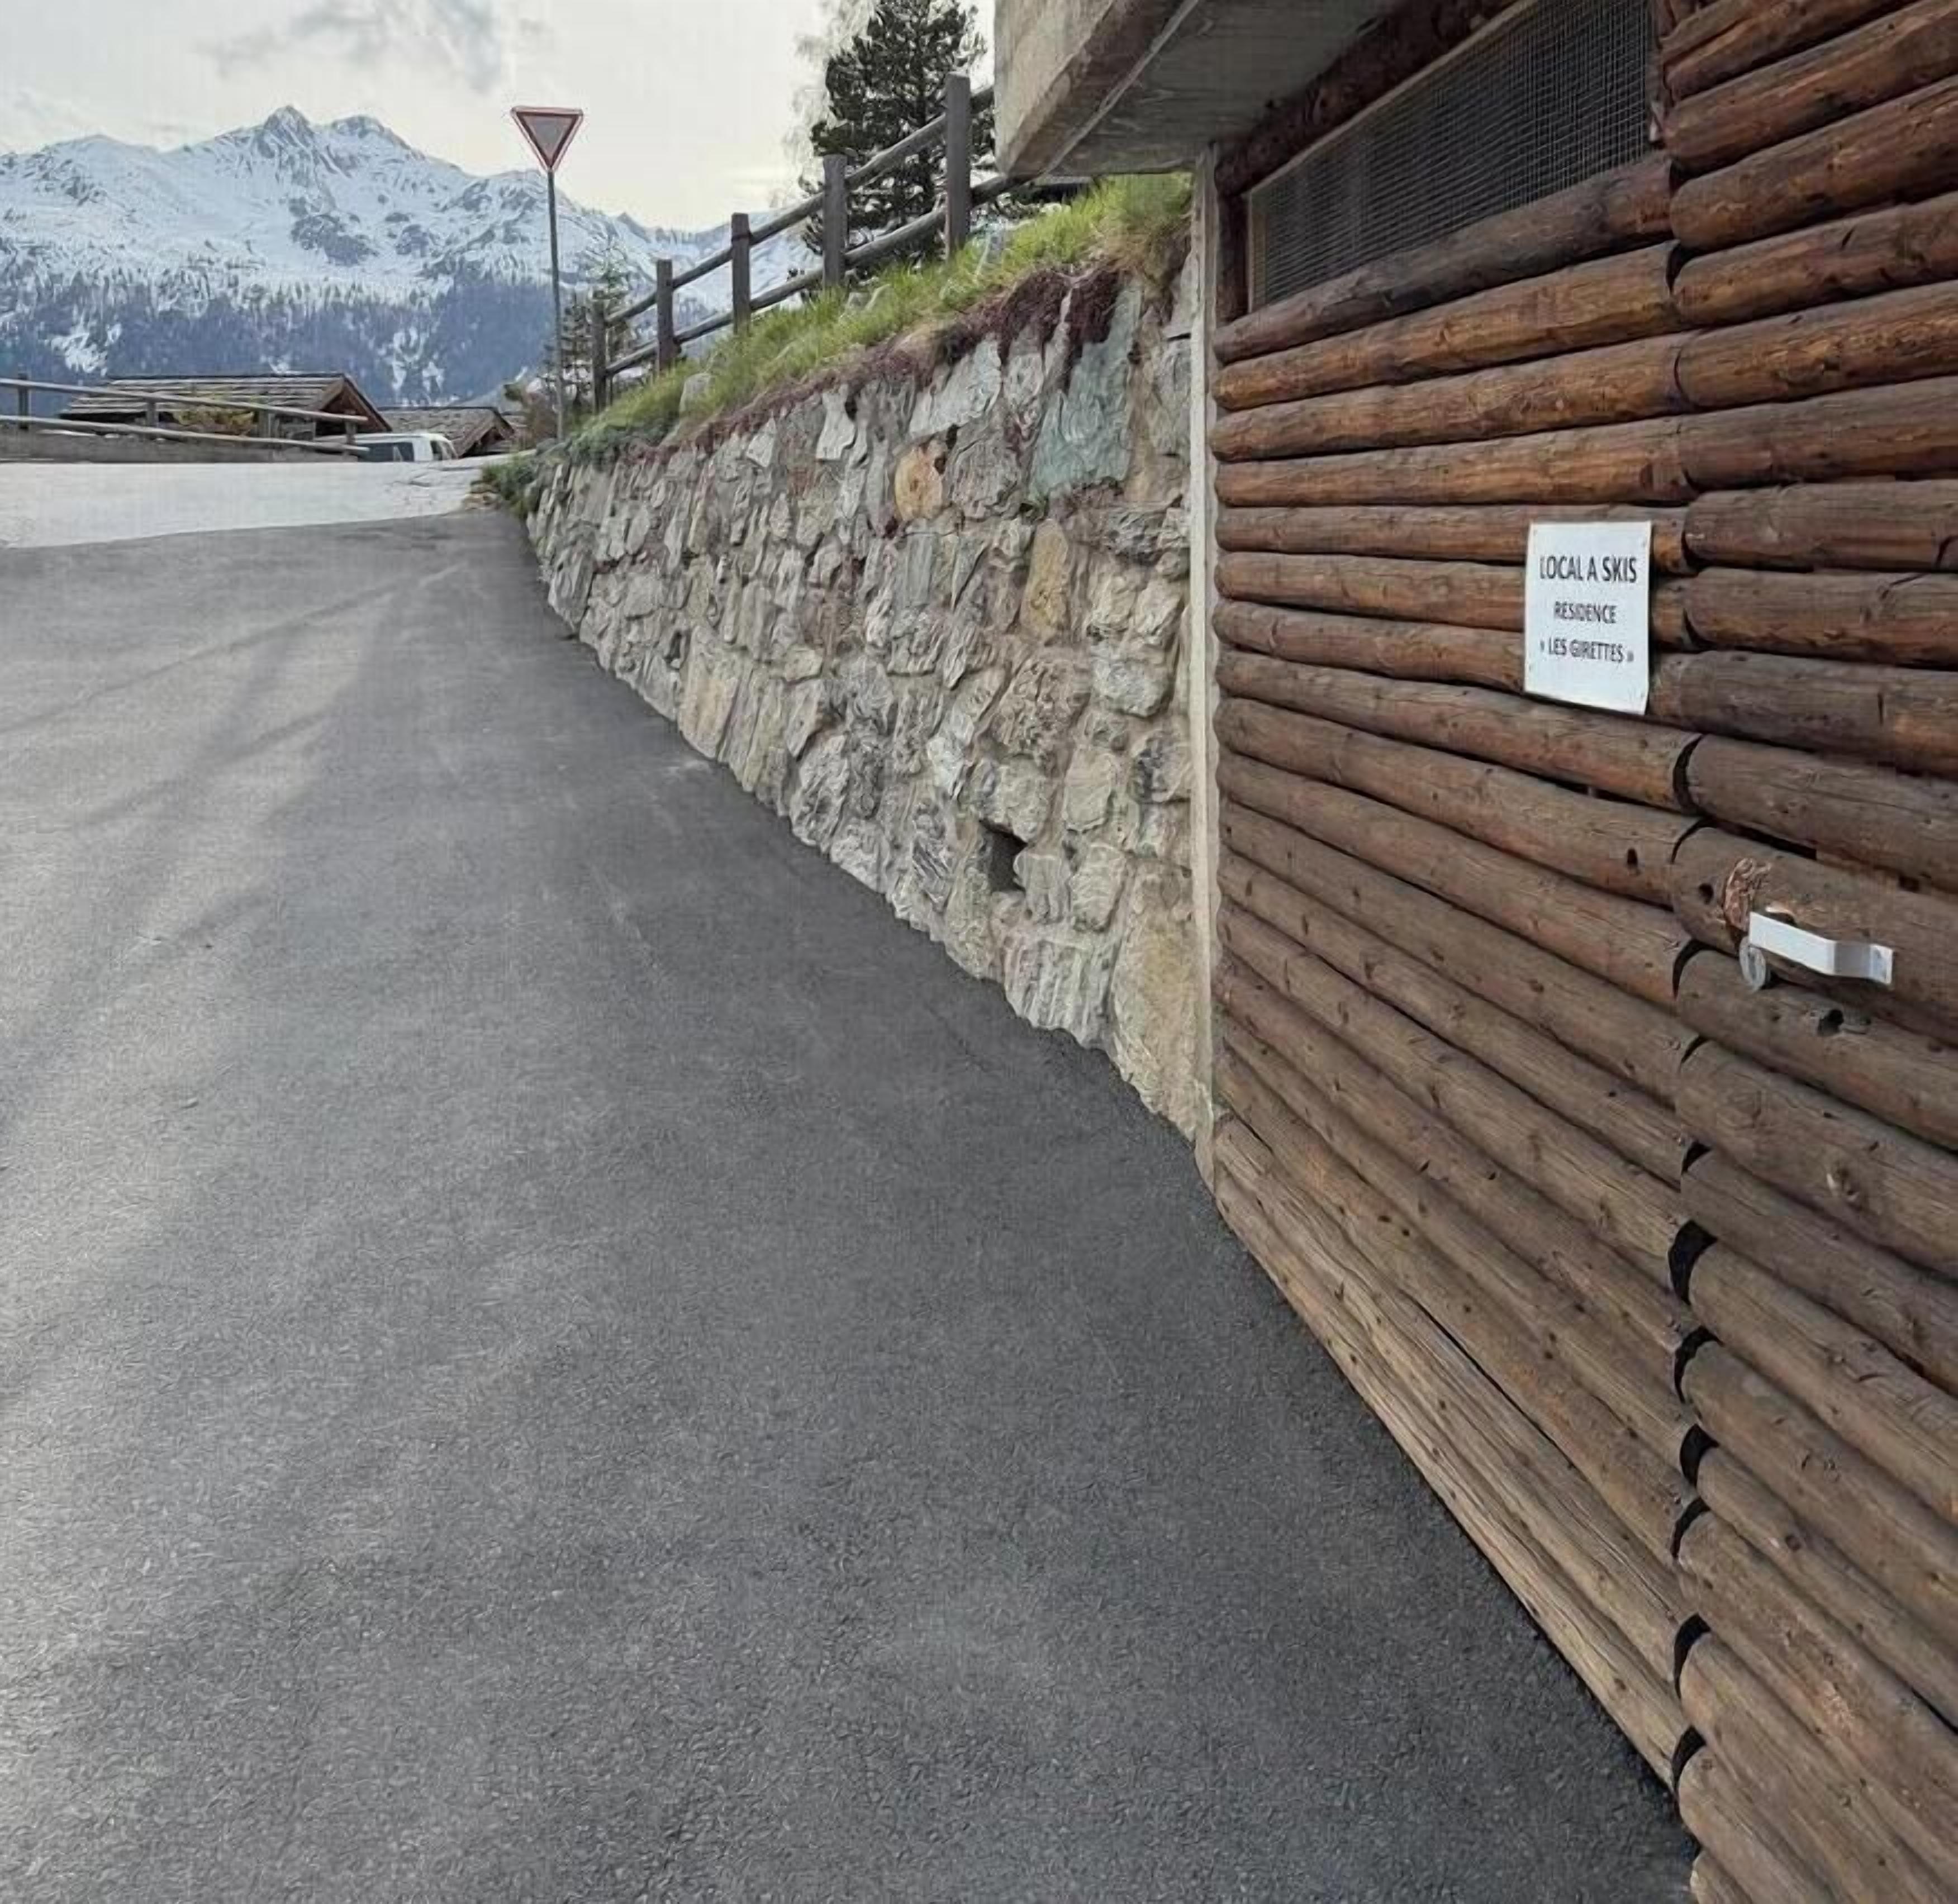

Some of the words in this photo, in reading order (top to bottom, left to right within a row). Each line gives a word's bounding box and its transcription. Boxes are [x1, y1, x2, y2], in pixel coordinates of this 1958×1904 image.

[1540, 555, 1583, 580] LOCAL
[1602, 556, 1637, 583] SKIS
[1554, 601, 1617, 623] RESIDENCE
